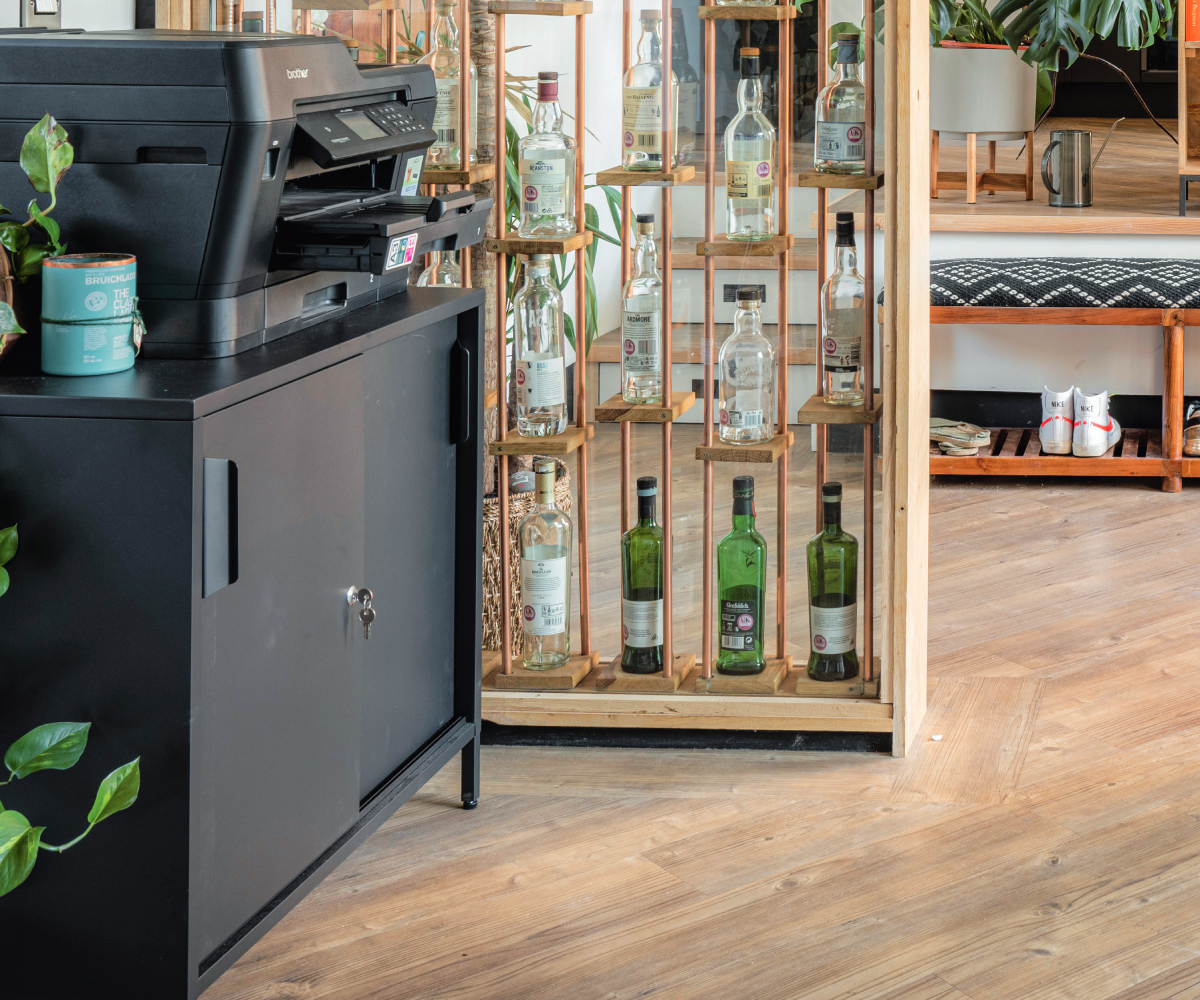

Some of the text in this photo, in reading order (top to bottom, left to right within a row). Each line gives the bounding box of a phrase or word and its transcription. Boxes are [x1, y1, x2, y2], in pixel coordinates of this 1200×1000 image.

[287, 68, 308, 79] brother
[85, 271, 136, 285] BRUICHLADD
[113, 287, 130, 300] THE
[113, 295, 135, 310] CLAS
